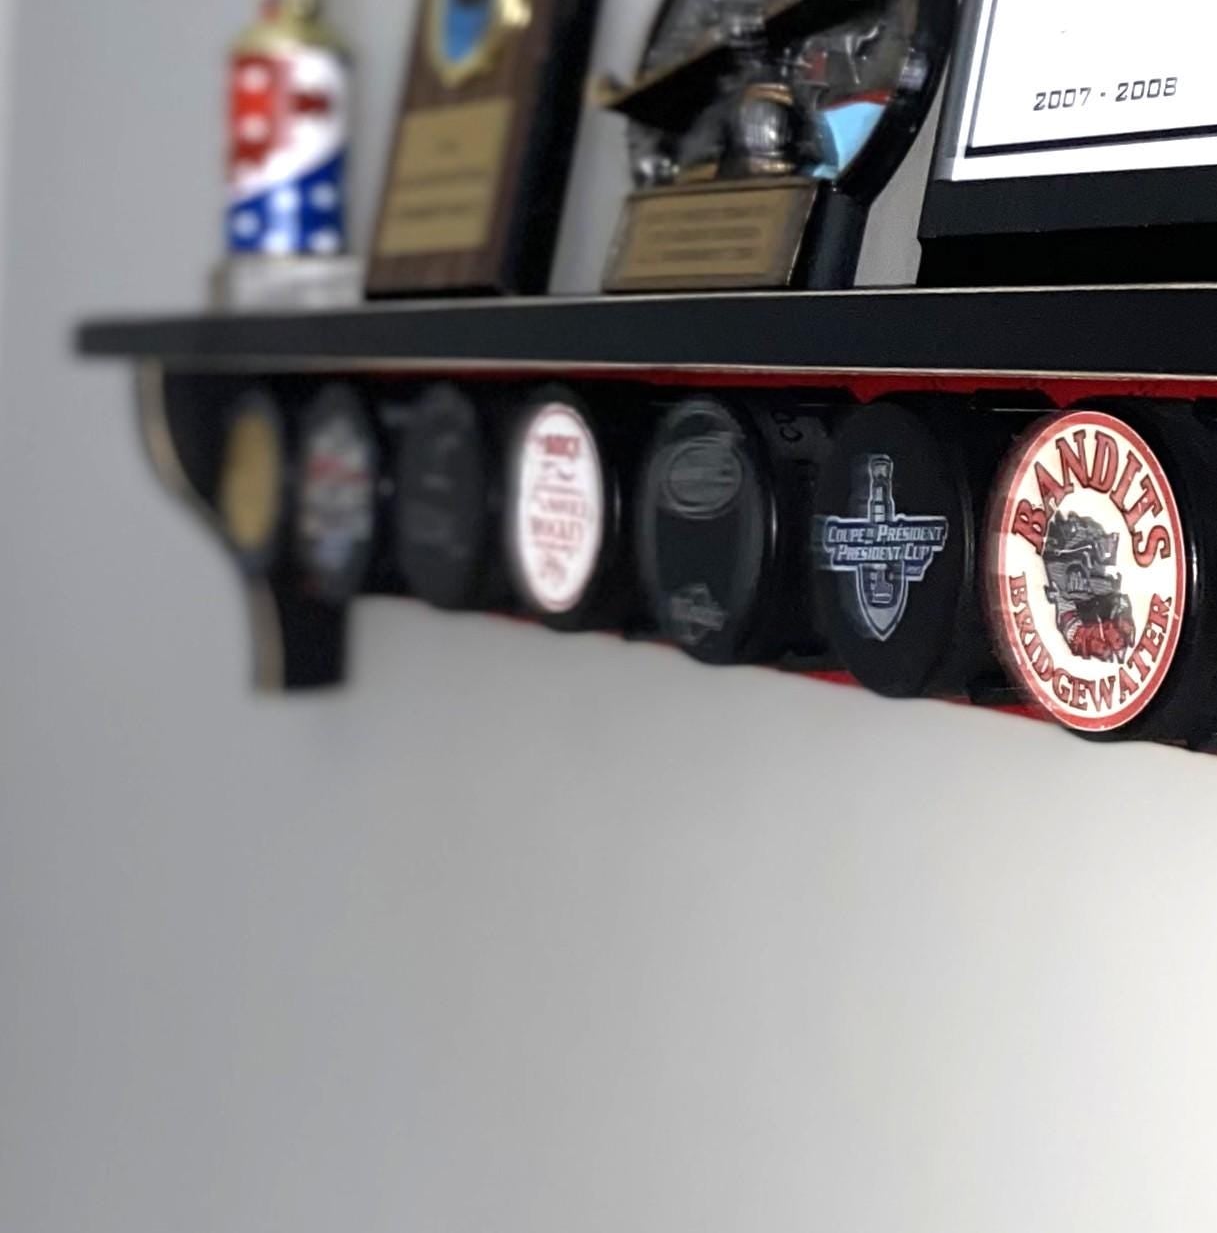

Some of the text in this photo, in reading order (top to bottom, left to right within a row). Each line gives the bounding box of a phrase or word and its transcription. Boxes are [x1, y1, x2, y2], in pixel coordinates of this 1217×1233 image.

[1033, 86, 1092, 112] 2007
[1115, 76, 1178, 103] 2008
[1012, 428, 1172, 568] BANDITS
[827, 525, 866, 543] COUPE
[836, 542, 930, 561] PRESIDENT CUP
[1009, 571, 1172, 712] BRIDGEWATER
